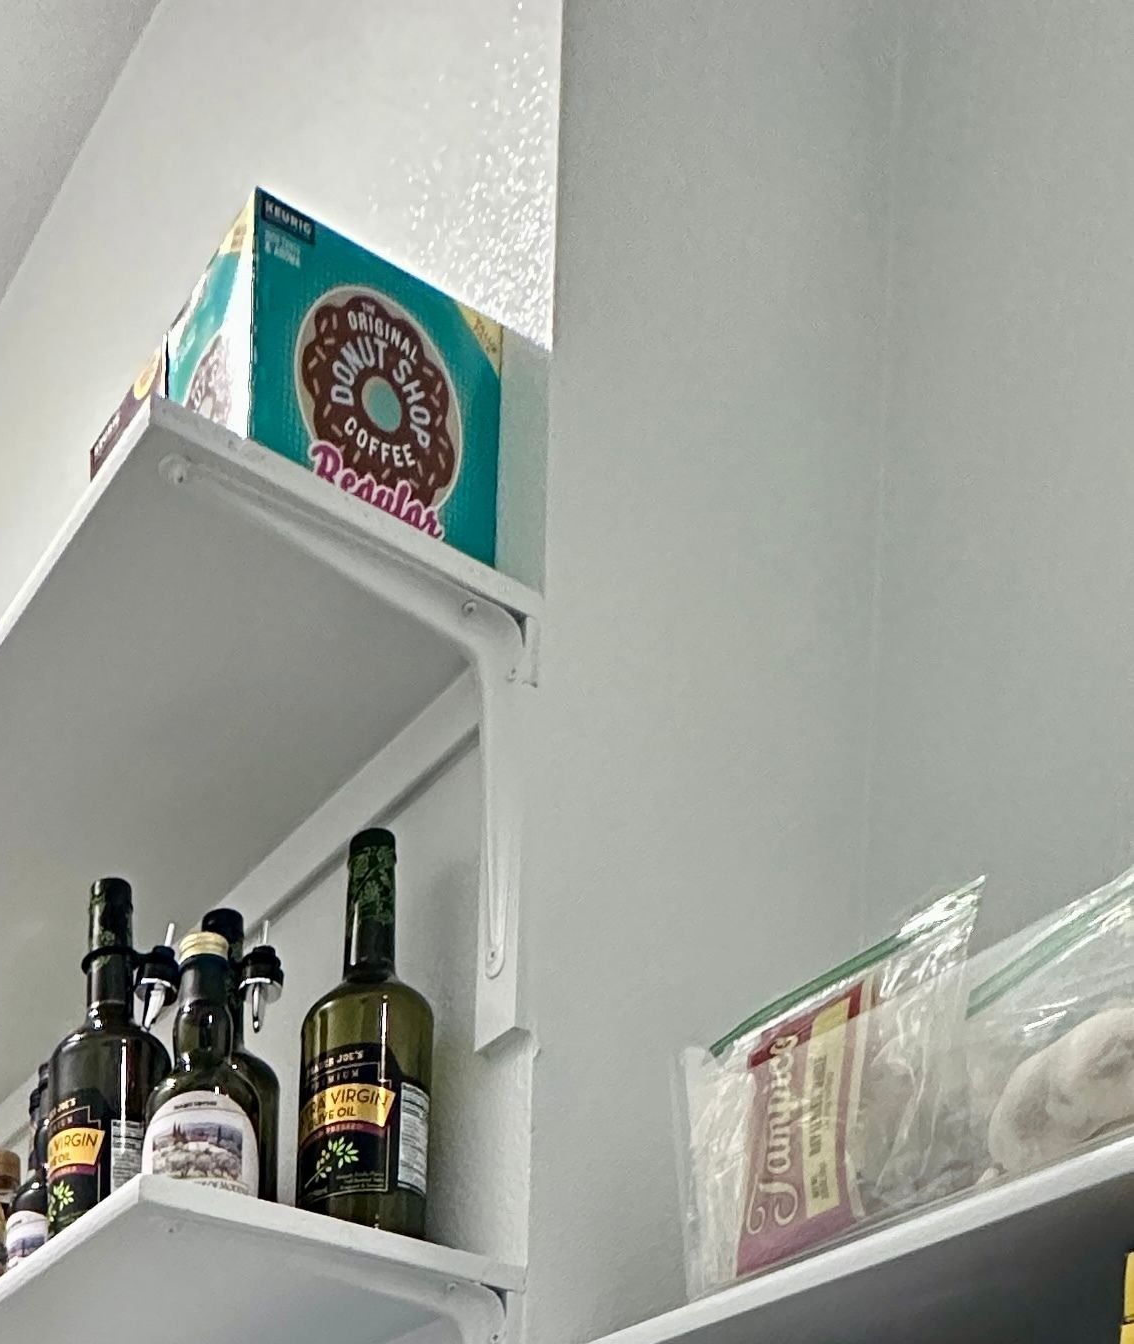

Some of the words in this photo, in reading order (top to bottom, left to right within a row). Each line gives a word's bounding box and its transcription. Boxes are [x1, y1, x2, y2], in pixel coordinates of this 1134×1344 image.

[347, 310, 419, 363] ORIGINAL
[331, 336, 388, 407] DONUT
[391, 358, 431, 450] SHOP
[344, 416, 416, 468] COFFEE
[331, 1088, 390, 1107] VIRGIN
[337, 1106, 356, 1118] OIL
